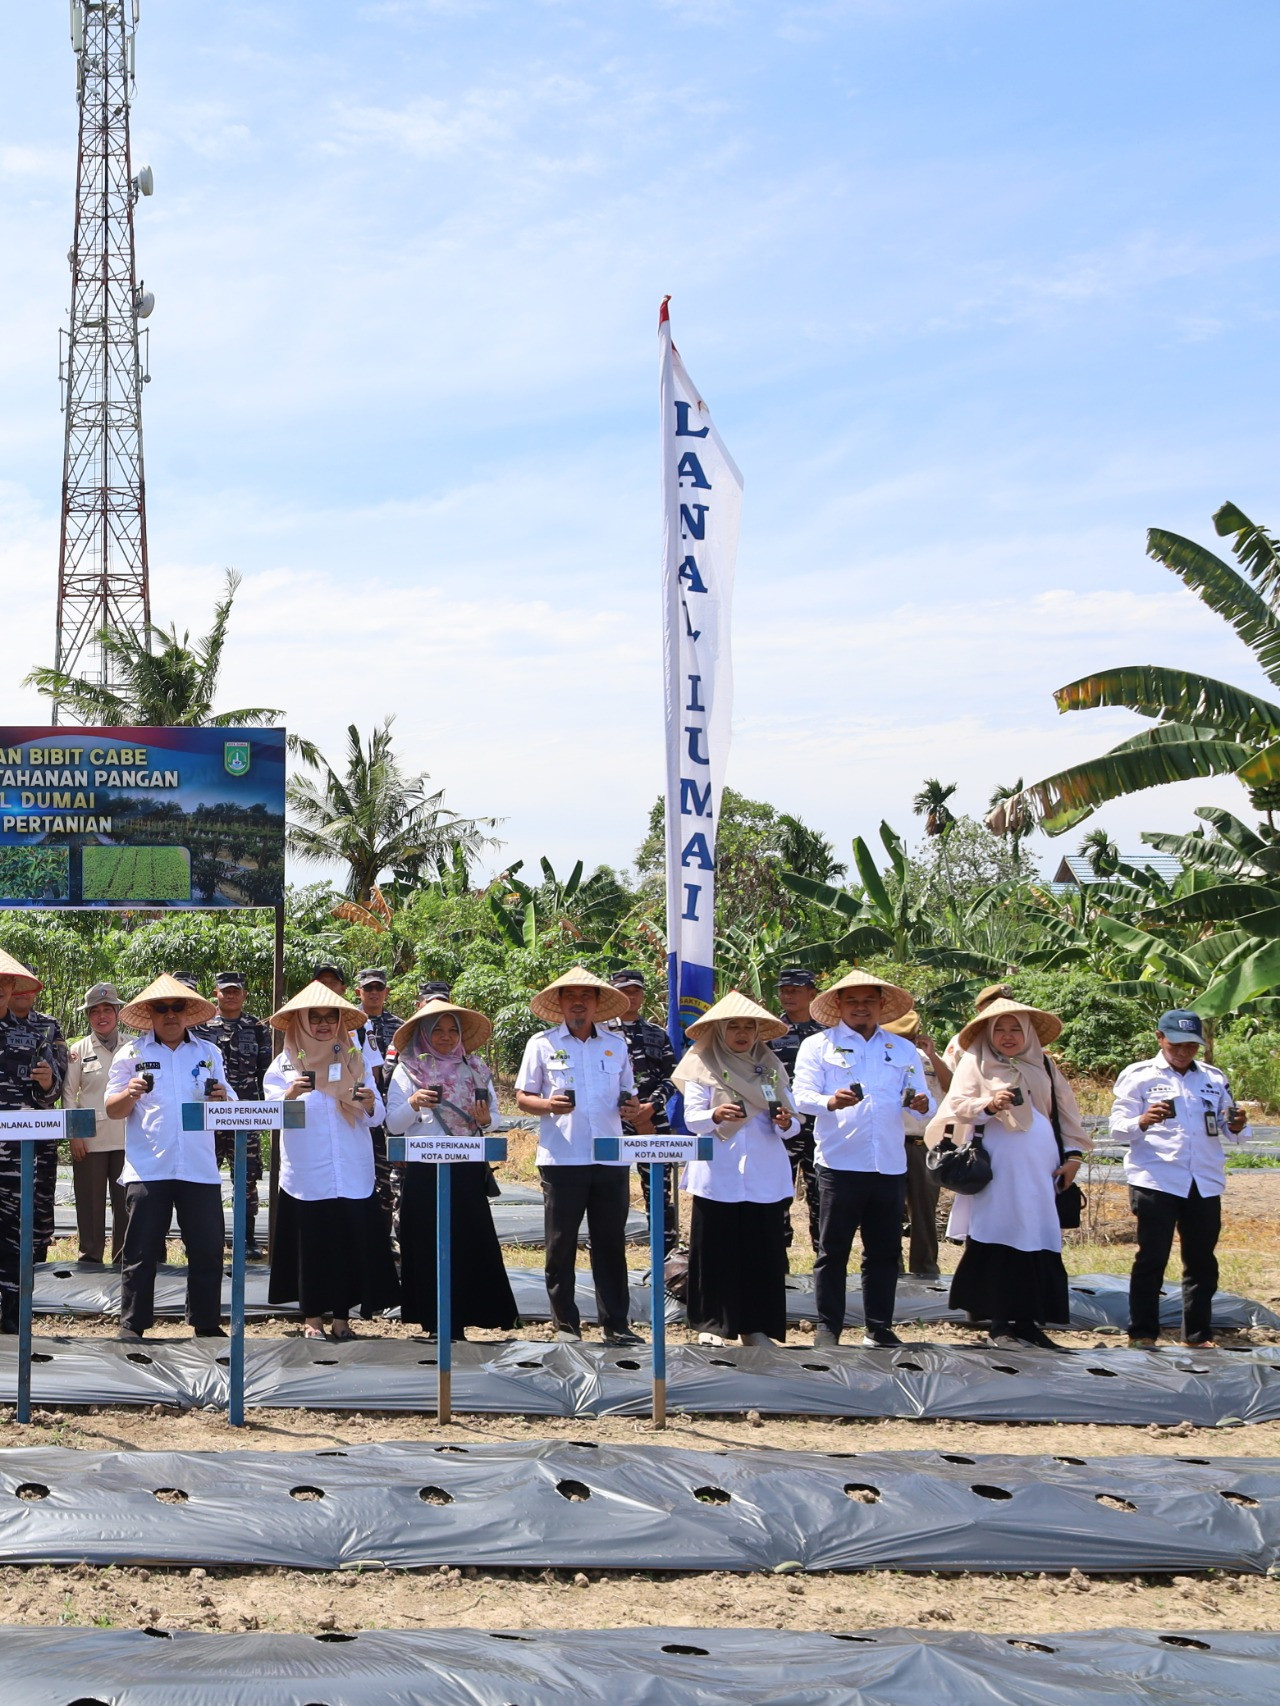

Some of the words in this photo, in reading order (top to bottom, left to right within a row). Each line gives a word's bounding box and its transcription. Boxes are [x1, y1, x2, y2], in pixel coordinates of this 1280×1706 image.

[29, 748, 84, 765] BIBIT
[89, 748, 148, 766] CABE
[94, 770, 178, 787] PANGAN
[21, 791, 95, 809] DUMAI
[3, 815, 112, 833] PERTANIAN
[208, 1107, 233, 1115] KADIS
[34, 1120, 61, 1128] DUMAI
[410, 1141, 434, 1149] KADIS
[624, 1140, 648, 1148] KADIS
[649, 1140, 693, 1148] PERTANIAN
